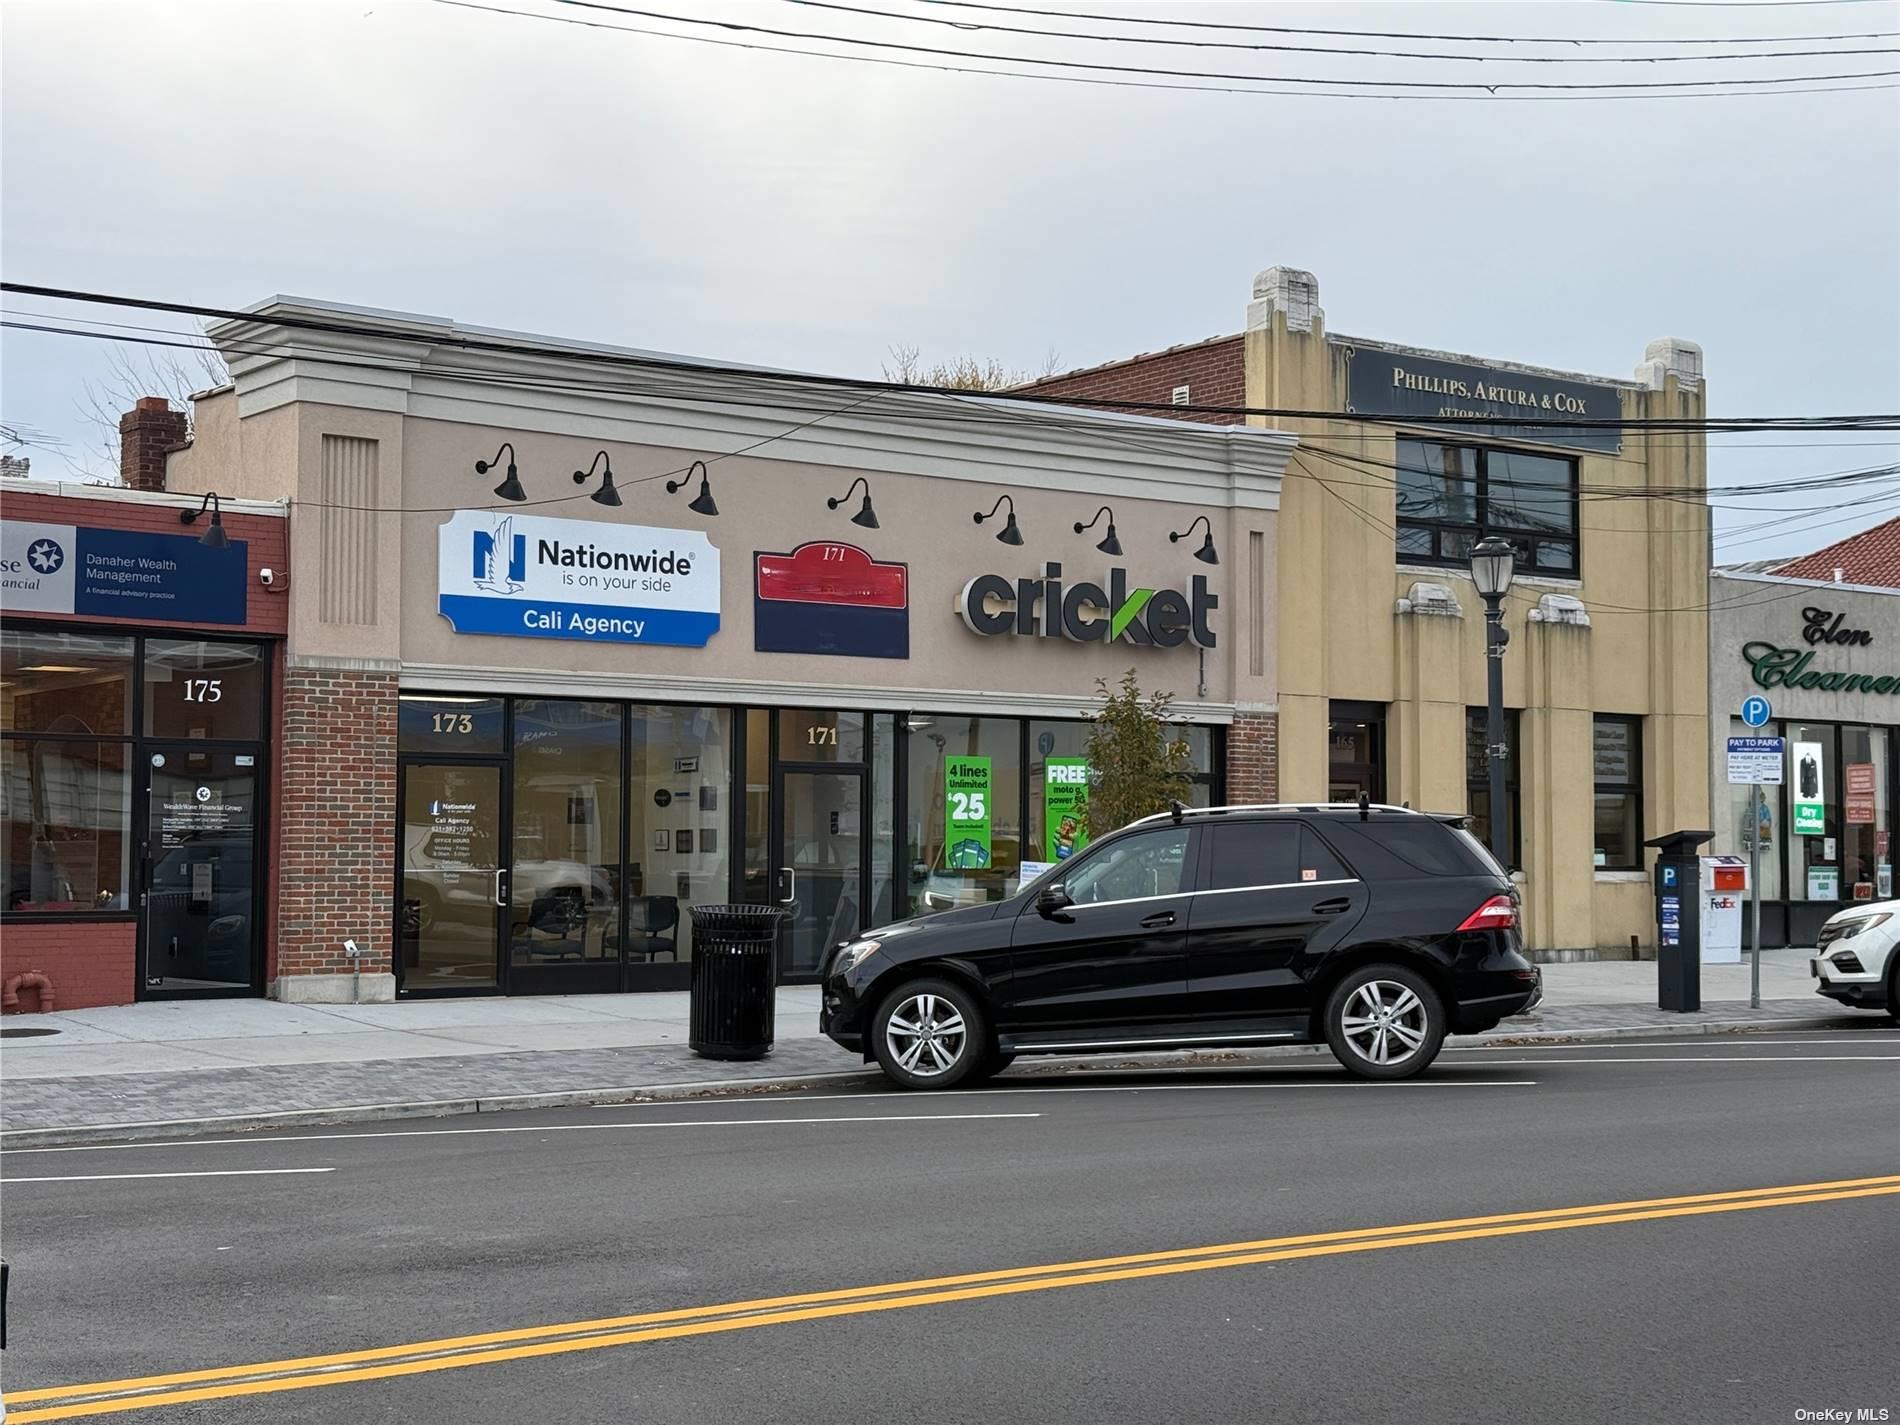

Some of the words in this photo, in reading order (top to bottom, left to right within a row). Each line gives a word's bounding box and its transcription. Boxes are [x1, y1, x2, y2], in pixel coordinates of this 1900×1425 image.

[1541, 394, 1551, 409] &
[86, 553, 135, 567] Danaher
[138, 557, 177, 570] Wealth
[823, 547, 846, 562] 171
[86, 567, 161, 583] Management
[562, 570, 574, 585] is
[579, 574, 598, 587] on
[603, 575, 636, 590] your
[642, 576, 672, 592] side
[961, 561, 1219, 648] cricket
[523, 609, 562, 630] Cali
[569, 612, 645, 637] Agency
[184, 679, 222, 702] 175
[1750, 701, 1763, 723] P
[432, 713, 473, 733] 173
[807, 727, 837, 745] 171
[949, 764, 957, 777] 4
[960, 764, 988, 777] lines
[1048, 765, 1086, 783] FREE
[949, 779, 988, 789] Unlimited
[1053, 786, 1074, 794] moto
[1048, 797, 1073, 806] power
[1801, 807, 1816, 818] Dry
[1664, 868, 1675, 884] P
[1711, 897, 1736, 909] FedEx
